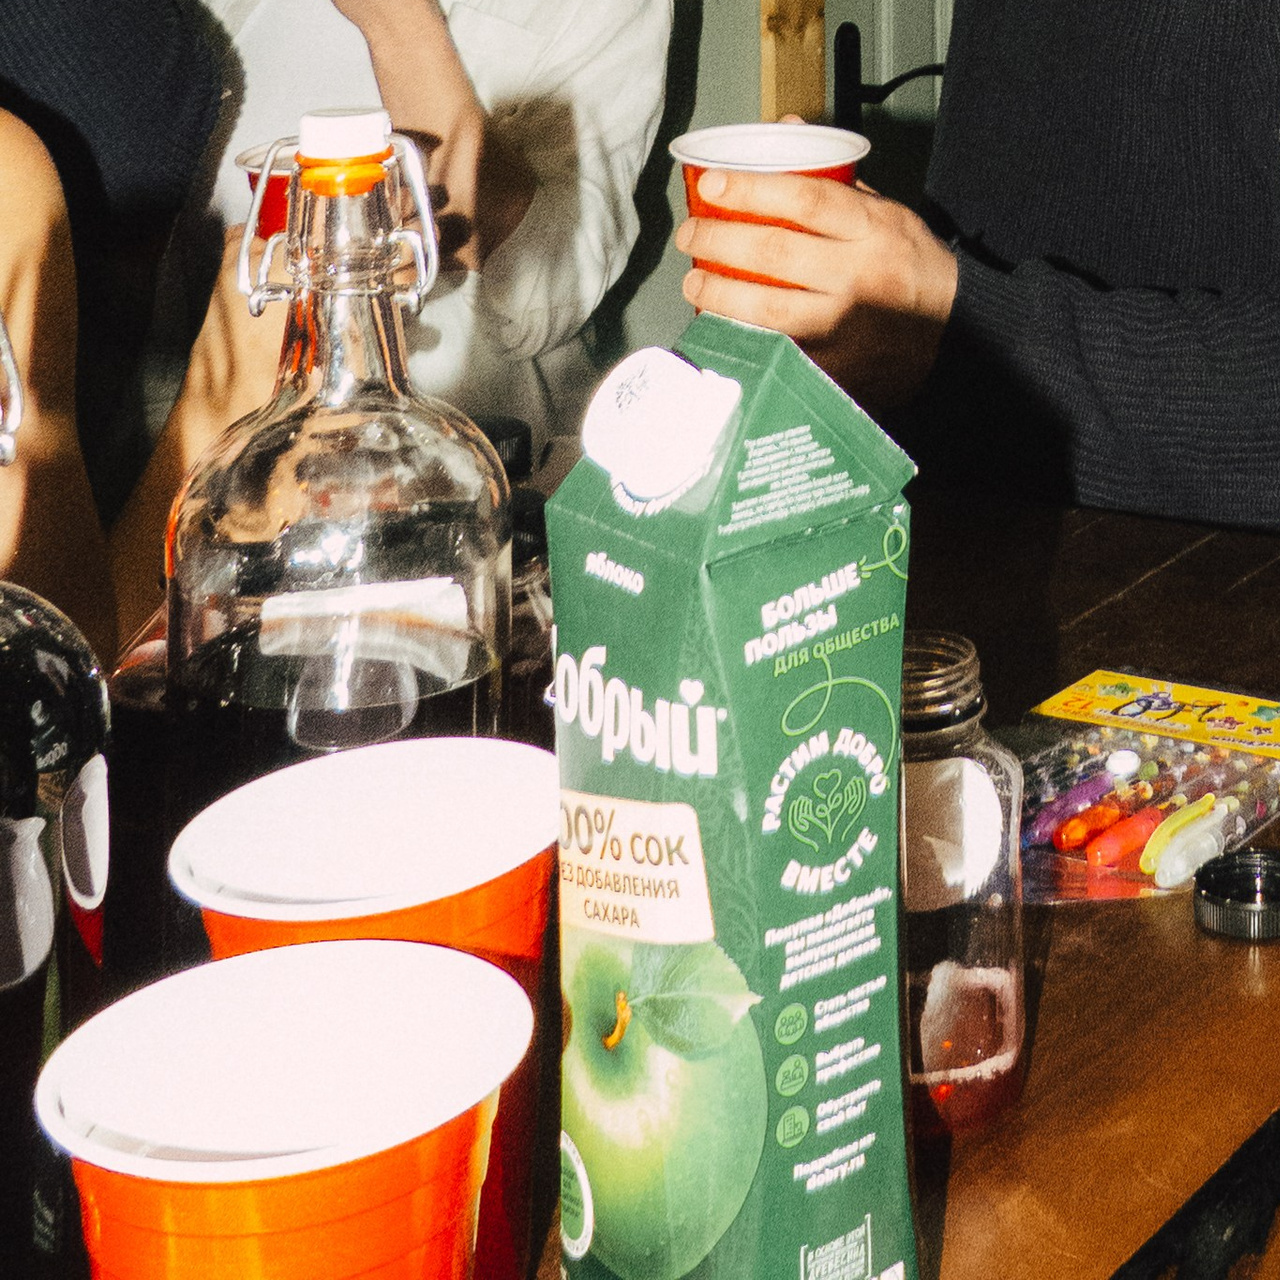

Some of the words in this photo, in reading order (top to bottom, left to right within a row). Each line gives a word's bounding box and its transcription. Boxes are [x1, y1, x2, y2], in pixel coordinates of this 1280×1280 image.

[761, 562, 860, 630] БОЛЬШЕ
[745, 605, 838, 666] ПОЛЬЗЫ
[773, 652, 809, 677] ДЛЯ
[812, 613, 900, 659] ОБЩЕСТВА
[544, 624, 719, 778] обрый
[762, 731, 829, 834] РАСТИМ
[833, 728, 886, 796] ДОБРО
[560, 800, 621, 861] 00%
[630, 831, 690, 866] СОК
[781, 827, 879, 893] ВМЕСТЕ
[560, 861, 574, 883] ЕЗ
[576, 865, 680, 899] ДОБАВЛЕНИЯ
[584, 897, 640, 929] САХАРА
